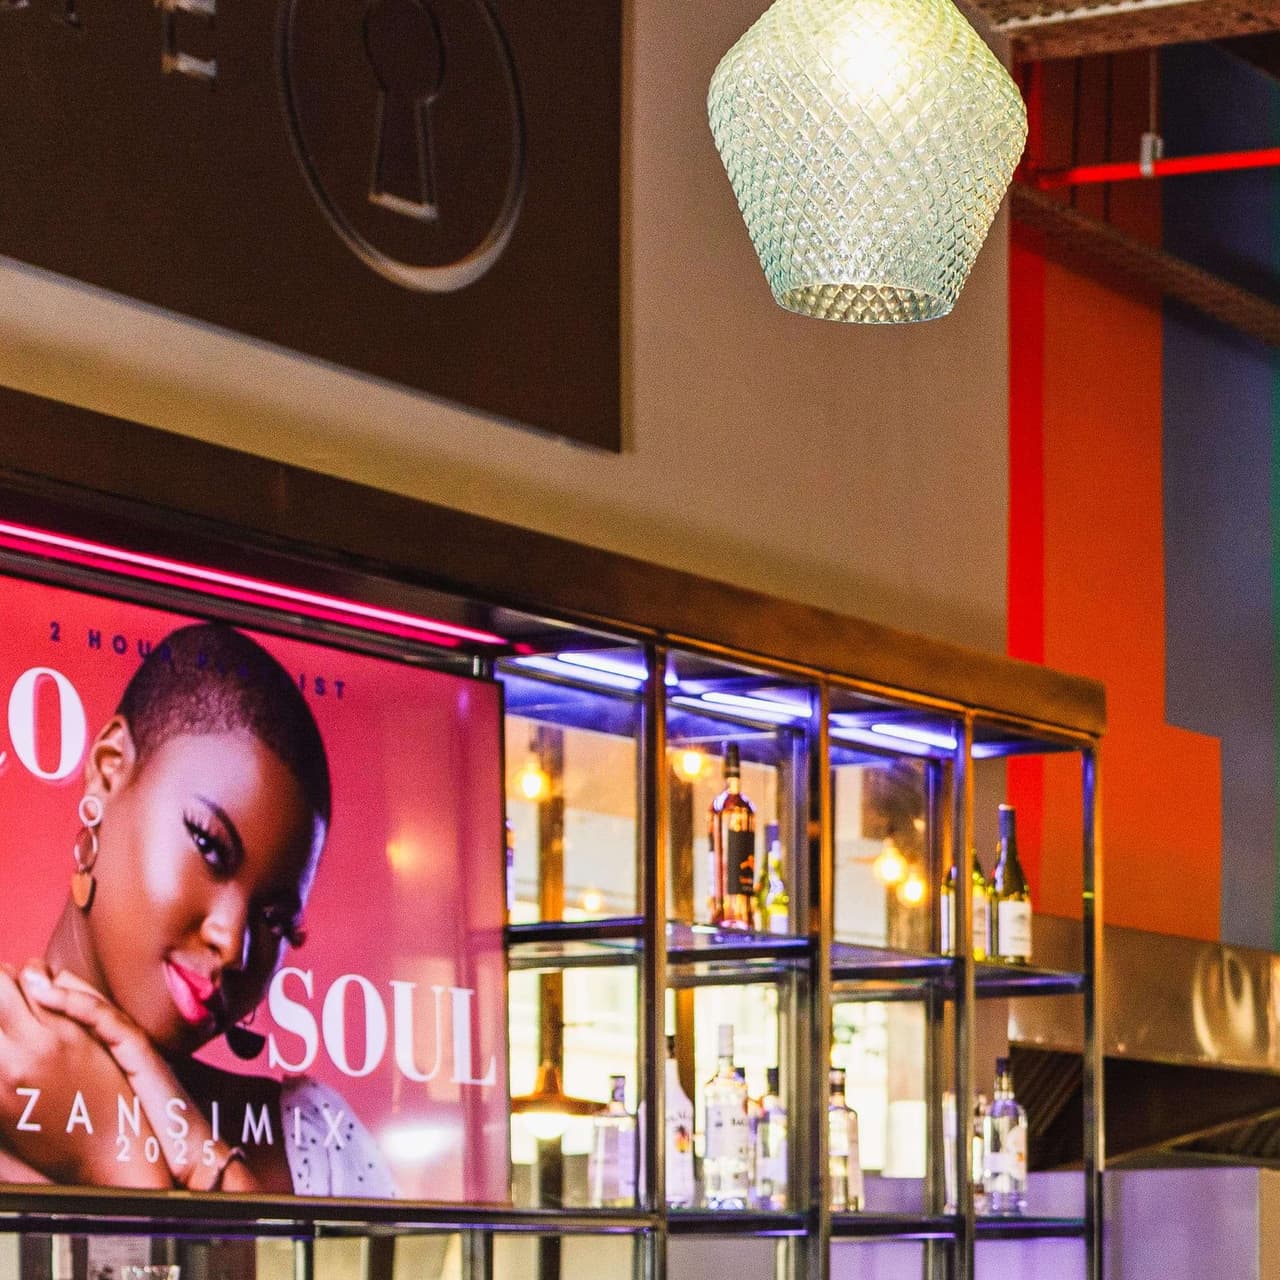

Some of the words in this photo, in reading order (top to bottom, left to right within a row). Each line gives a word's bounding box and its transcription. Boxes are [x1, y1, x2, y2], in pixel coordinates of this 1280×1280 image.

[50, 621, 60, 642] 2
[88, 629, 172, 664] HOUR
[0, 665, 88, 782] O
[268, 966, 496, 1087] SOUL
[15, 1087, 345, 1149] ZANSIMIX
[116, 1136, 217, 1167] 2025
